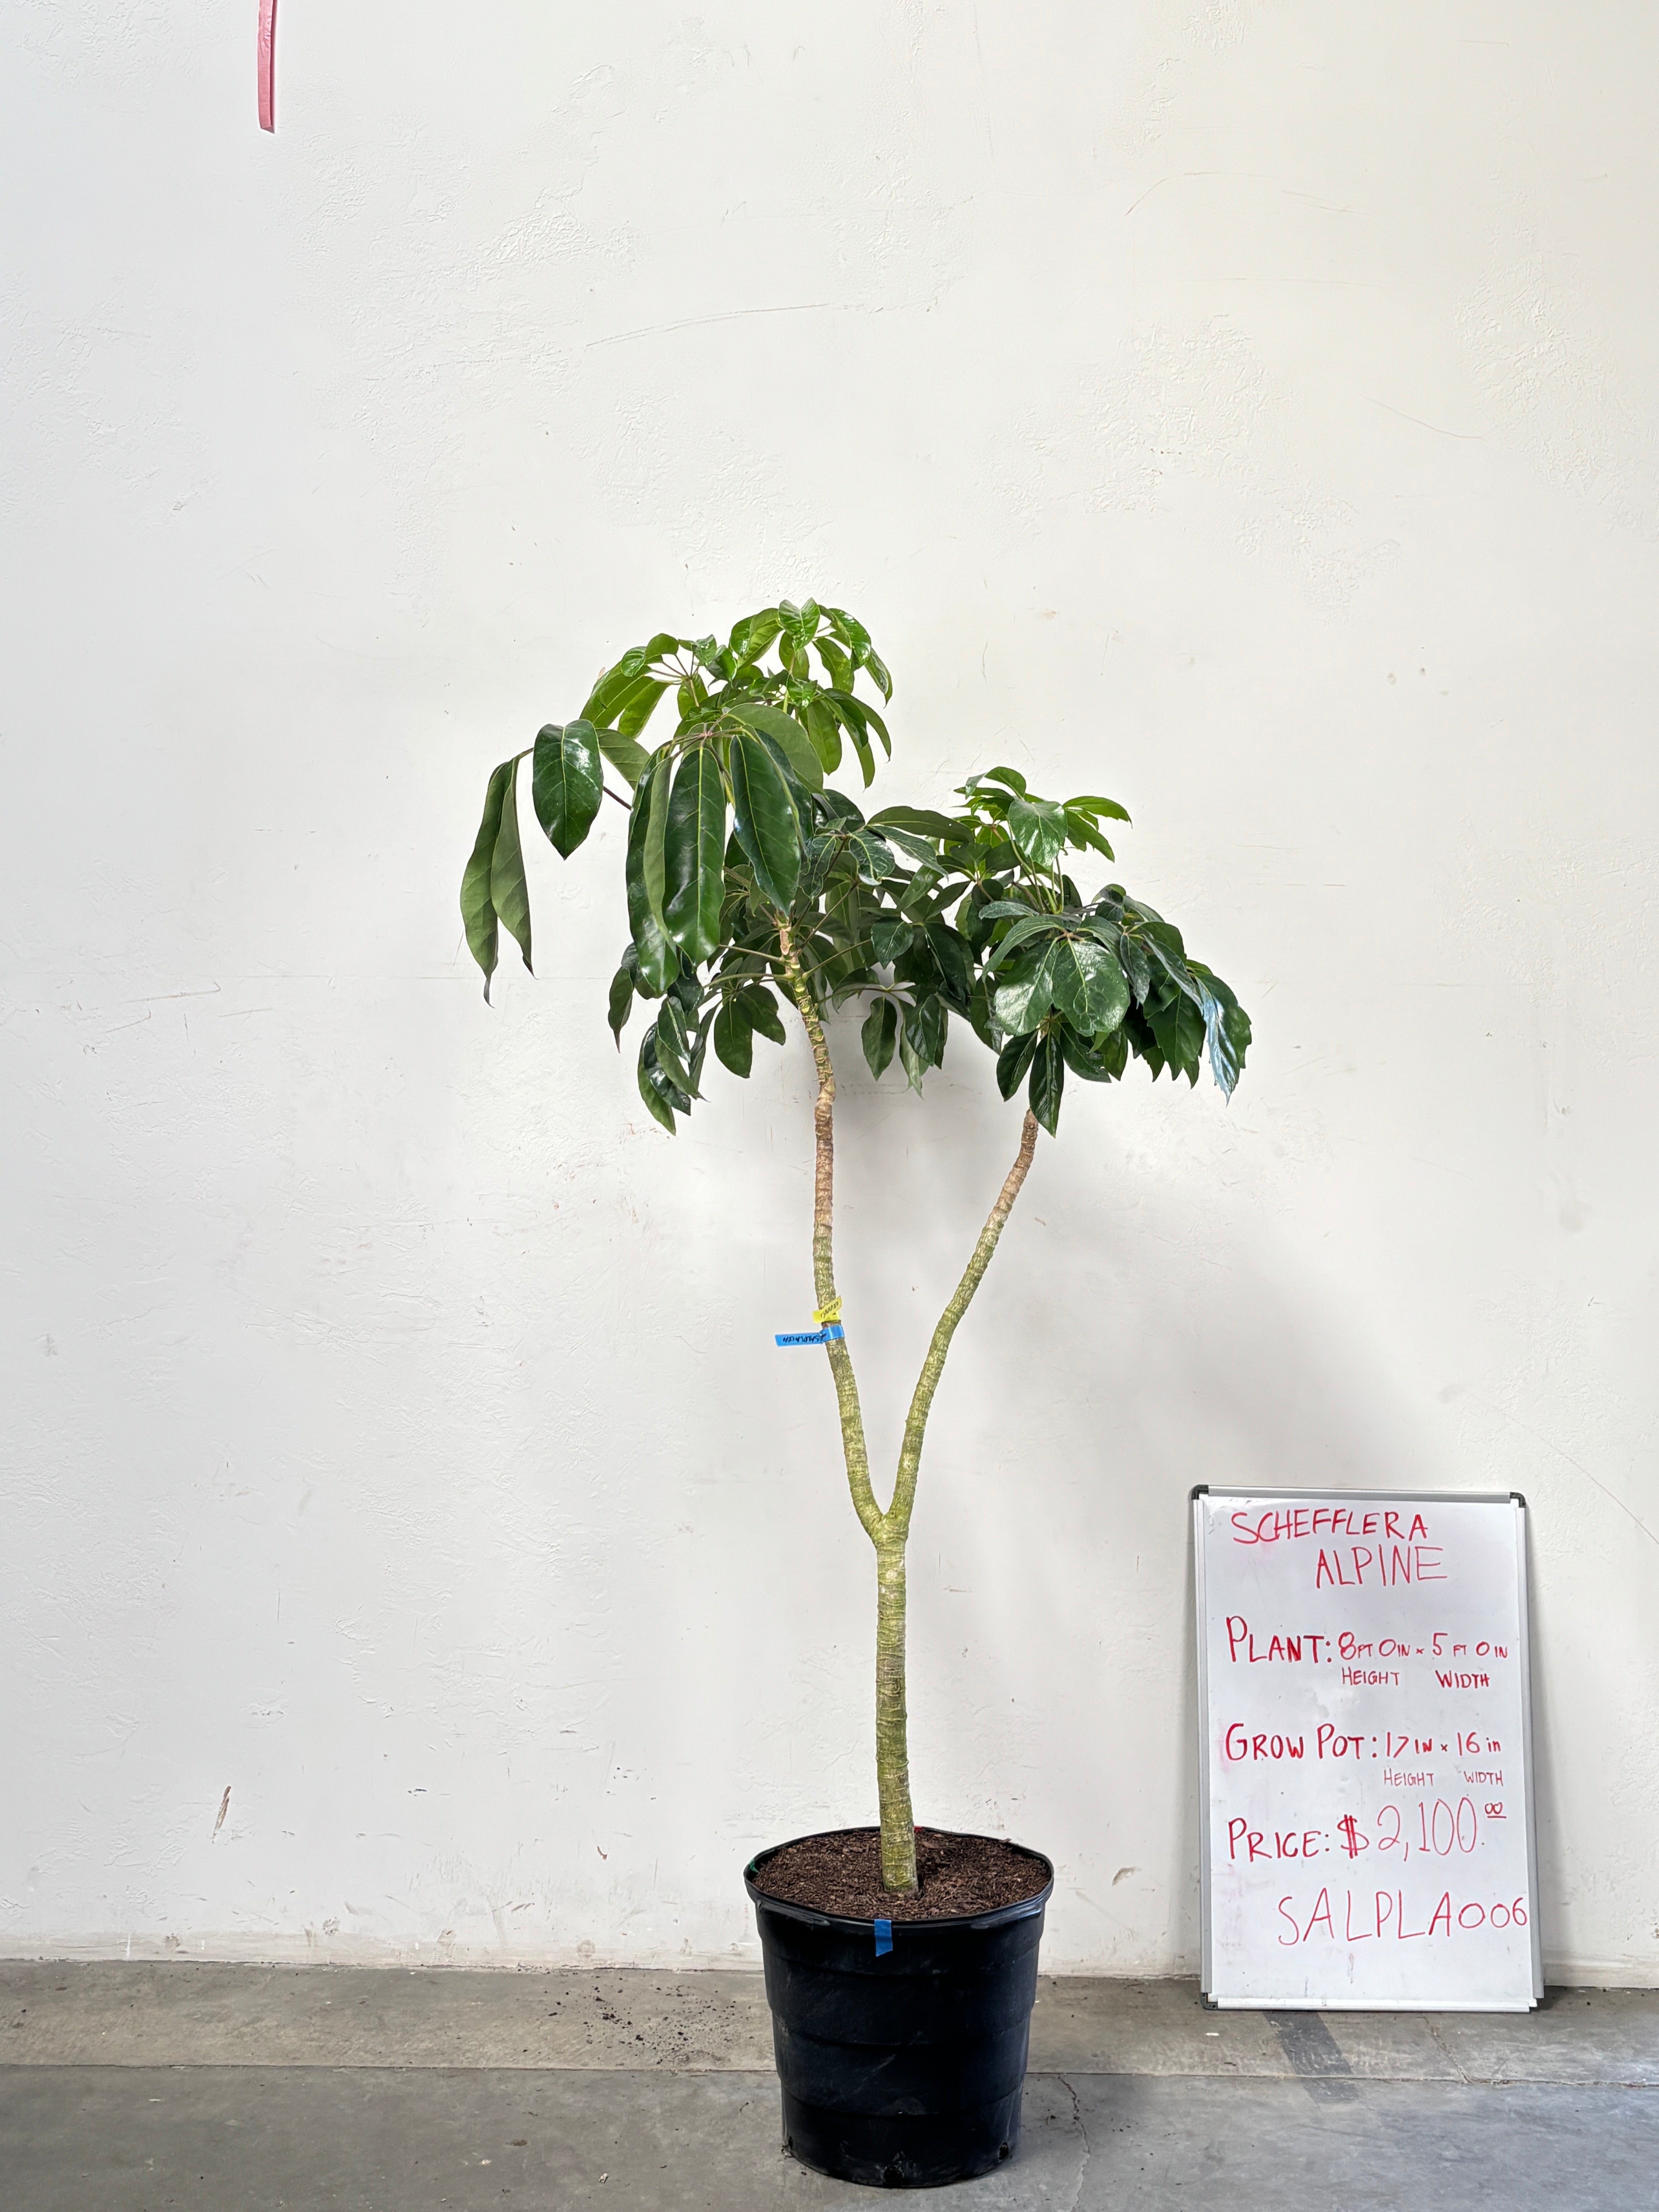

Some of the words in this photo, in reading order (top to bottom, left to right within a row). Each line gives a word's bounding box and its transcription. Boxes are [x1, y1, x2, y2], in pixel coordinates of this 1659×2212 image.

[1231, 1508, 1427, 1544] SCHEFFLERA
[1316, 1544, 1448, 1589] ALPINE
[1226, 1616, 1331, 1664] PLANT:
[1342, 1666, 1400, 1686] HEIGHT
[1435, 1670, 1489, 1688] WIDTH
[1225, 1723, 1304, 1761] GROW
[1317, 1724, 1377, 1759] POT:
[1383, 1768, 1434, 1786] HEIGHT
[1464, 1770, 1504, 1786] WIDTH
[1228, 1818, 1329, 1862] PRICE:
[1278, 1887, 1527, 1944] SALPLA006
